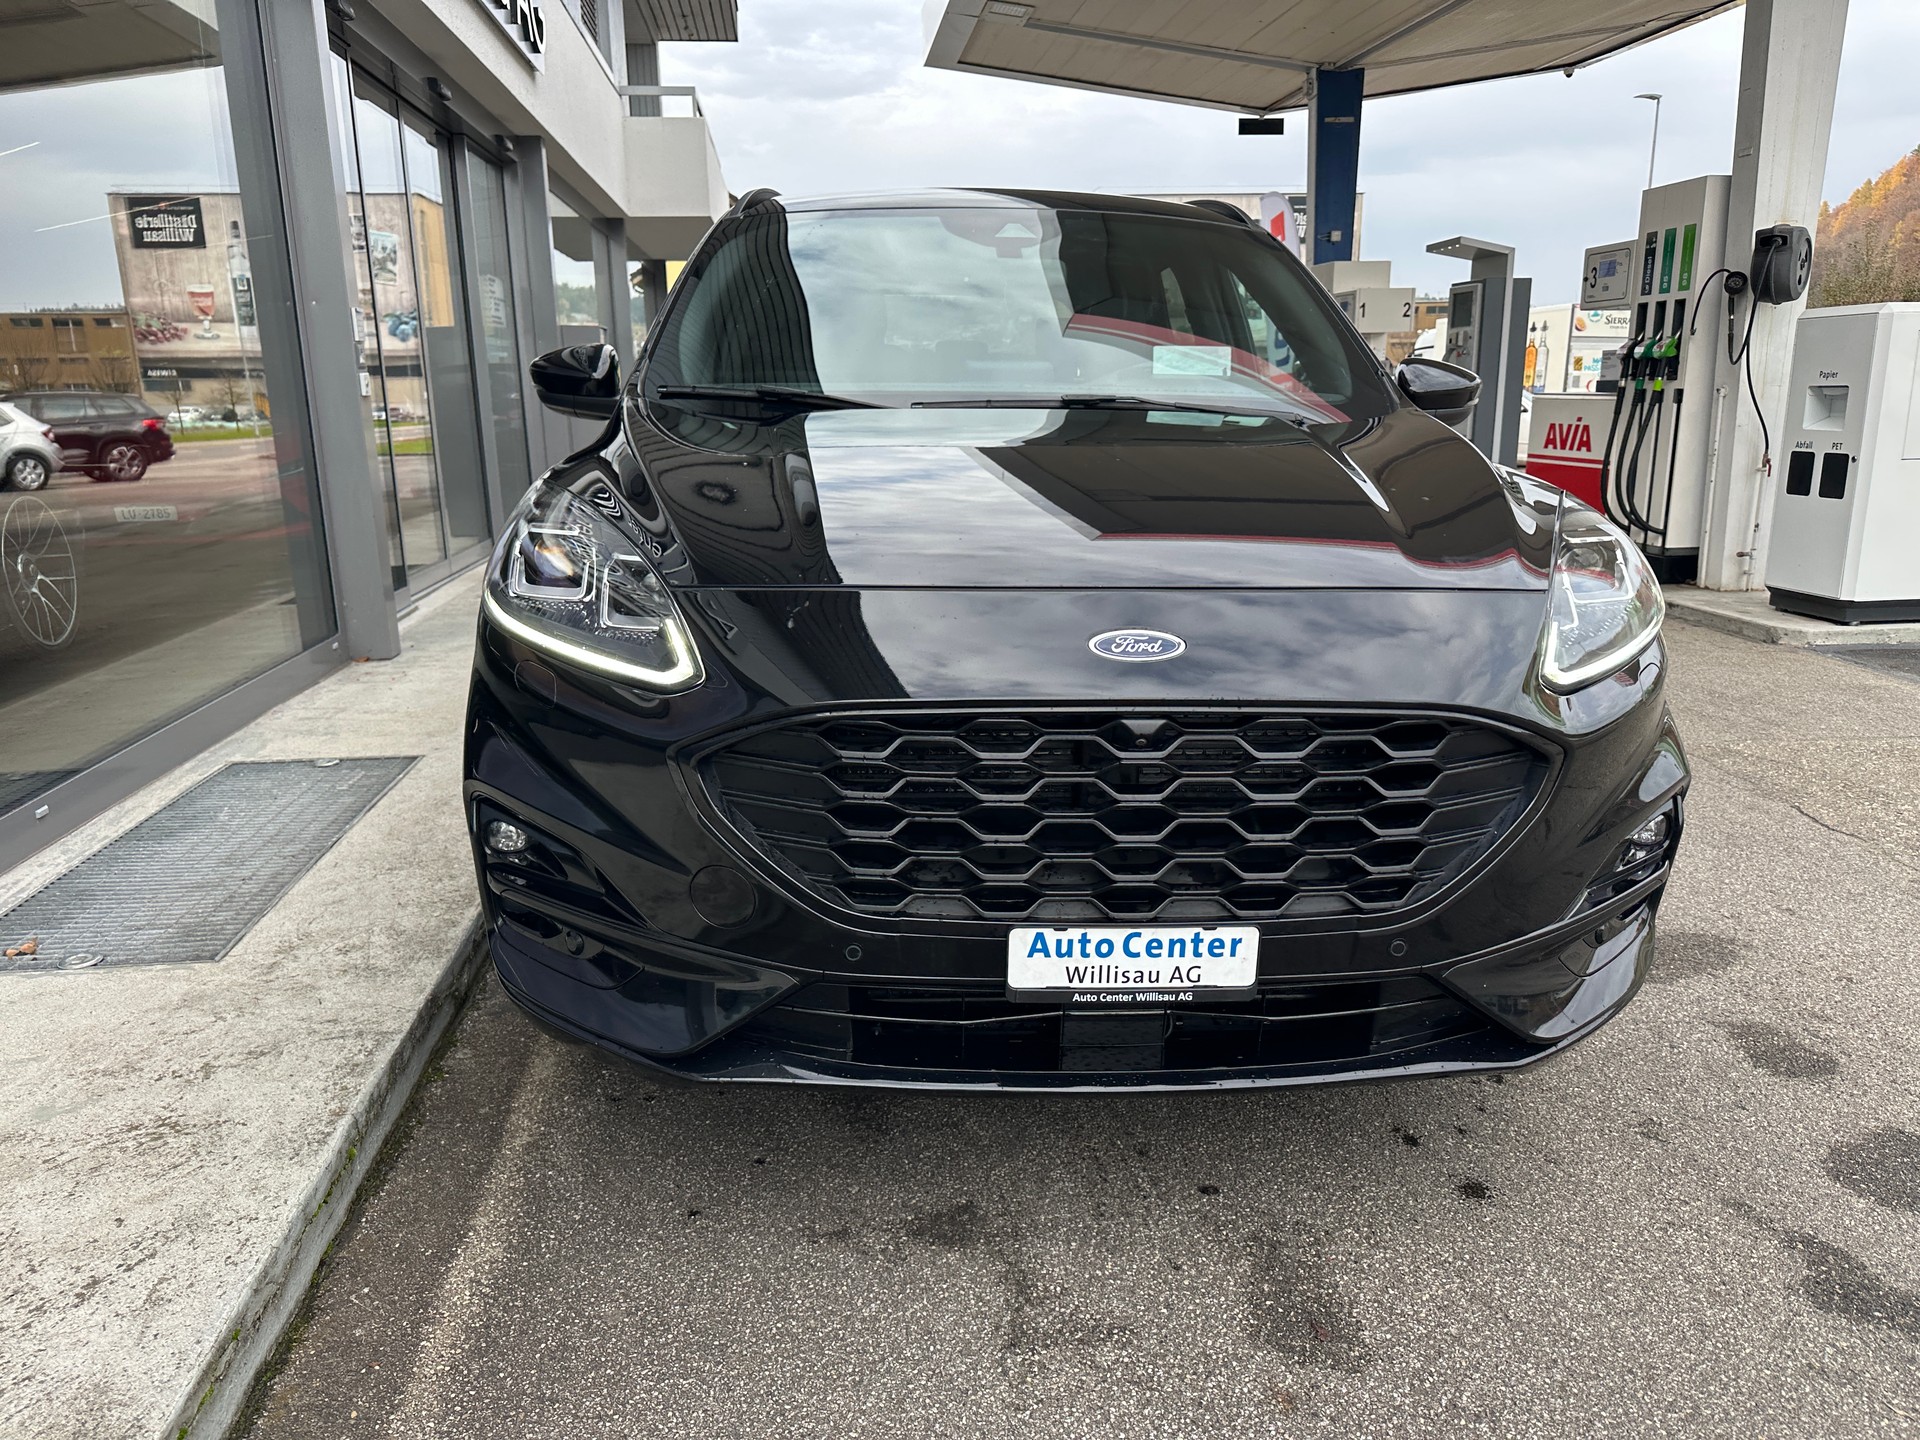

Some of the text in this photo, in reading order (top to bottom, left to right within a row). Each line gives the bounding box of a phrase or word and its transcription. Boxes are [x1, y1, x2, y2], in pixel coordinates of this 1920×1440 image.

[1589, 267, 1597, 288] 3
[1359, 302, 1366, 318] 1
[1402, 302, 1411, 318] 2
[1819, 371, 1838, 380] Papier
[1795, 441, 1813, 449] Abfall
[1832, 442, 1843, 451] PET
[1111, 635, 1163, 653] Ford
[1027, 931, 1243, 959] Auto Center
[1065, 965, 1202, 984] Willisau AG
[1072, 991, 1193, 1002] Auto Center Willisau AG
